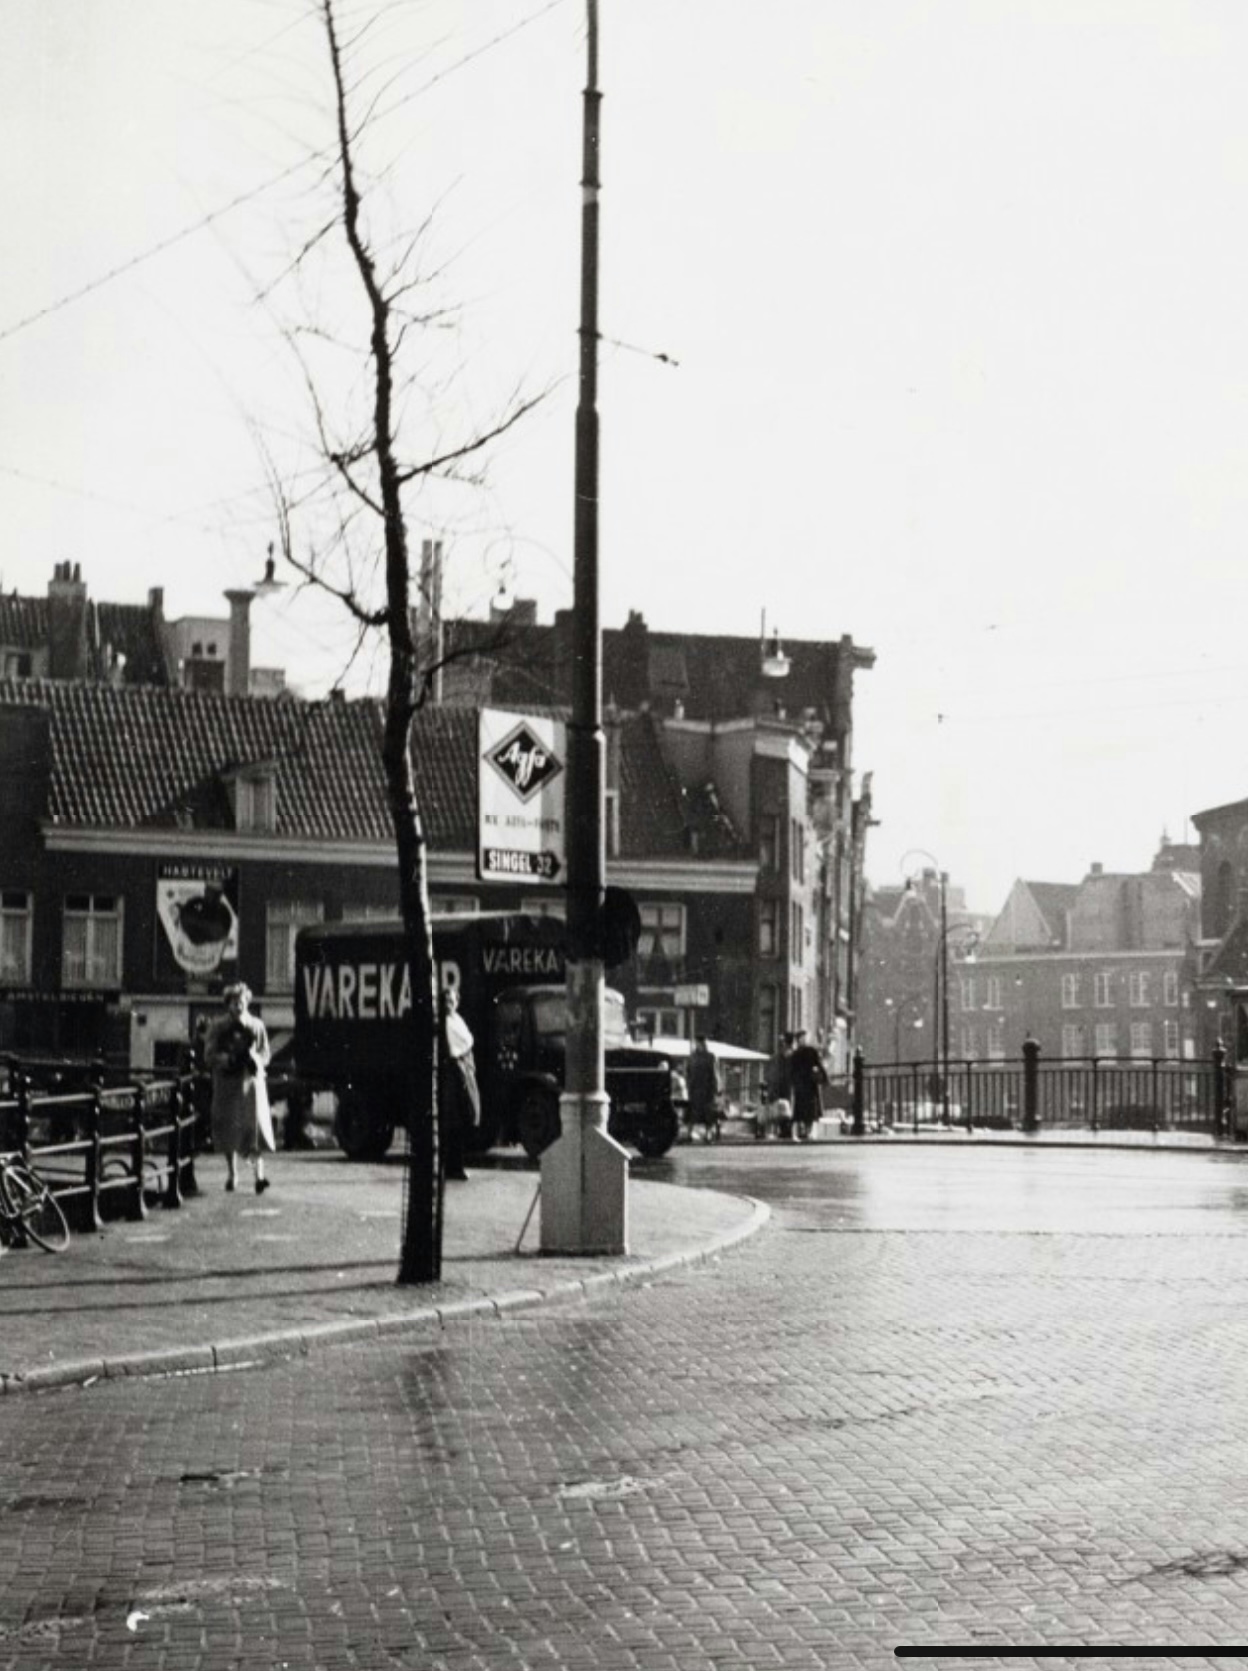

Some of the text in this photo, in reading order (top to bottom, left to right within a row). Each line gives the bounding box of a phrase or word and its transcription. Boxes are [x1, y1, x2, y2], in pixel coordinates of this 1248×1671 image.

[498, 741, 547, 787] Agfa
[489, 850, 552, 875] SINGEL 32
